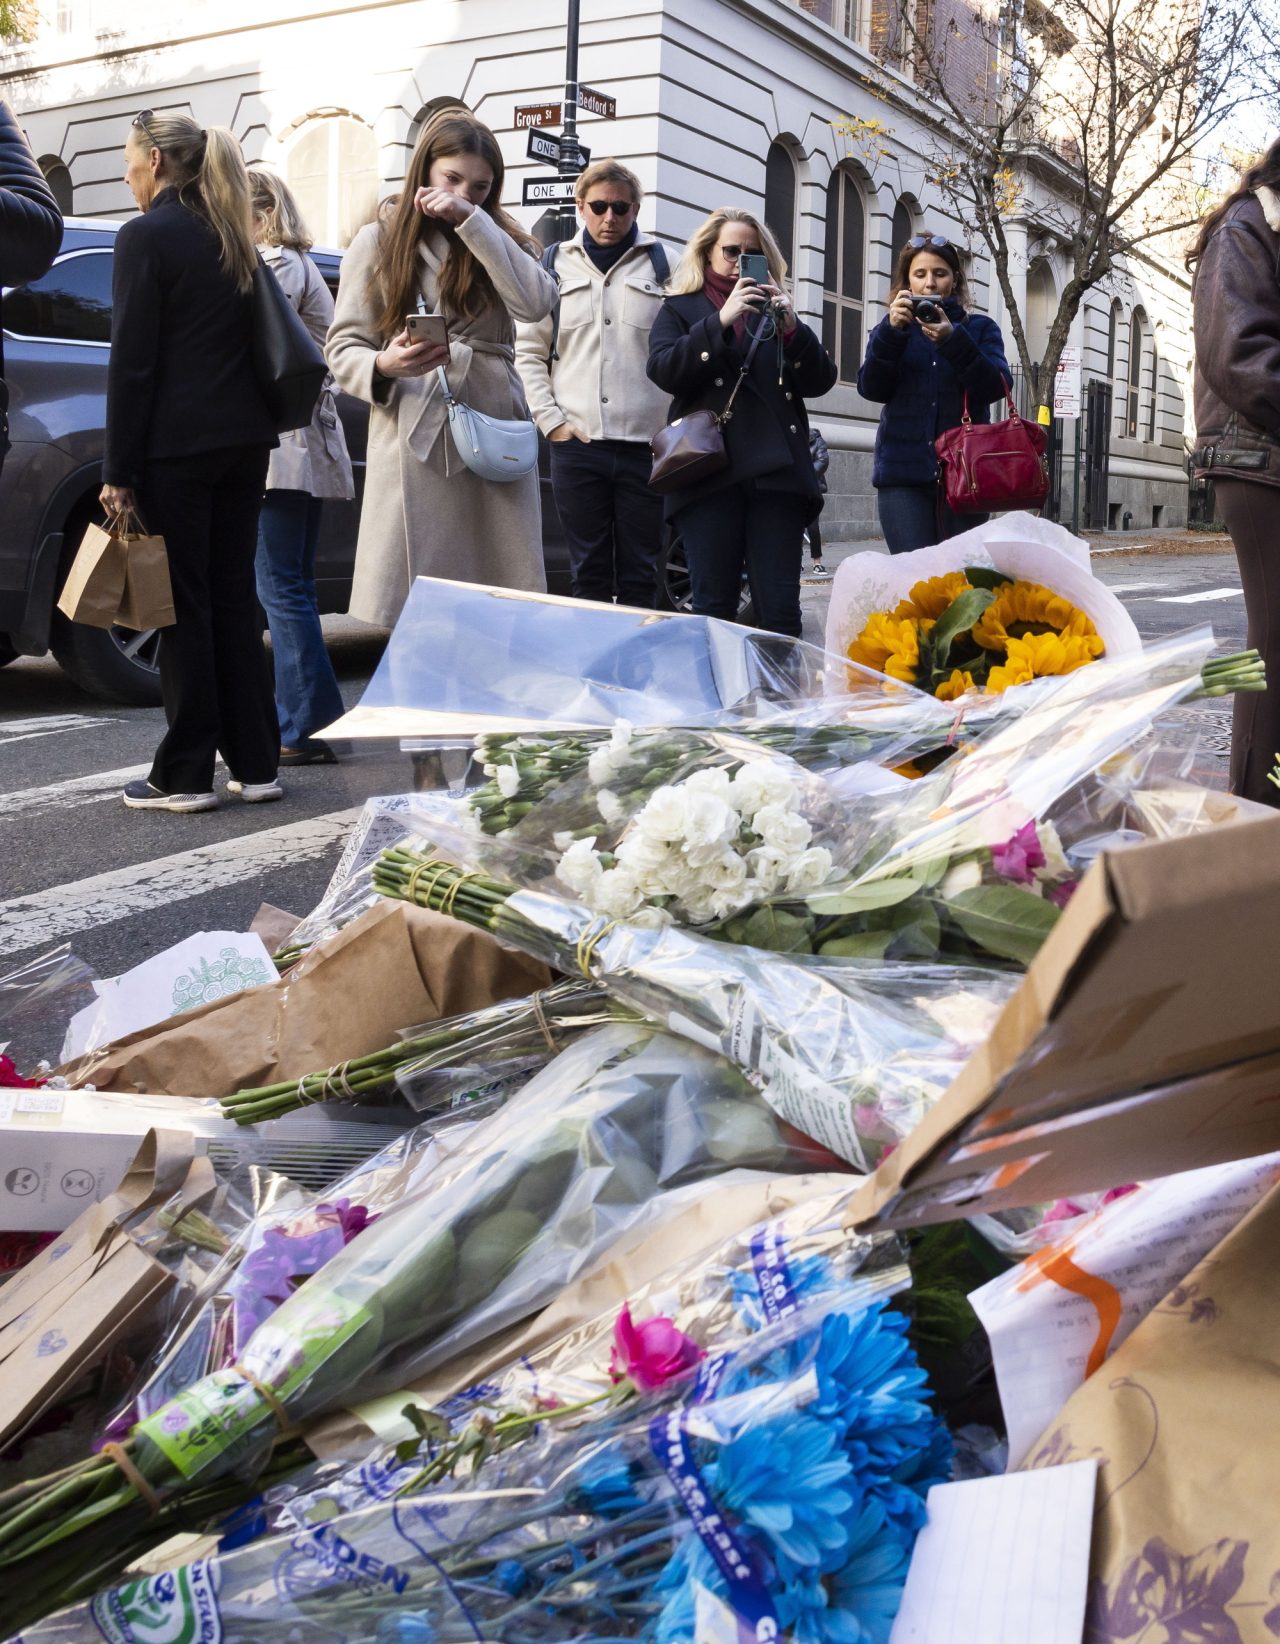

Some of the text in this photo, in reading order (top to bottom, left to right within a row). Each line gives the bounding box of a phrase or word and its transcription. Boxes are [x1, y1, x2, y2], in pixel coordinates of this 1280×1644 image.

[579, 91, 615, 115] Bedford St
[516, 110, 552, 127] Grove St
[536, 140, 555, 157] ONE
[533, 185, 555, 197] ONE
[758, 1269, 782, 1323] GOLDEN
[771, 1273, 787, 1300] to
[683, 1475, 706, 1508] to
[702, 1514, 751, 1580] Last
